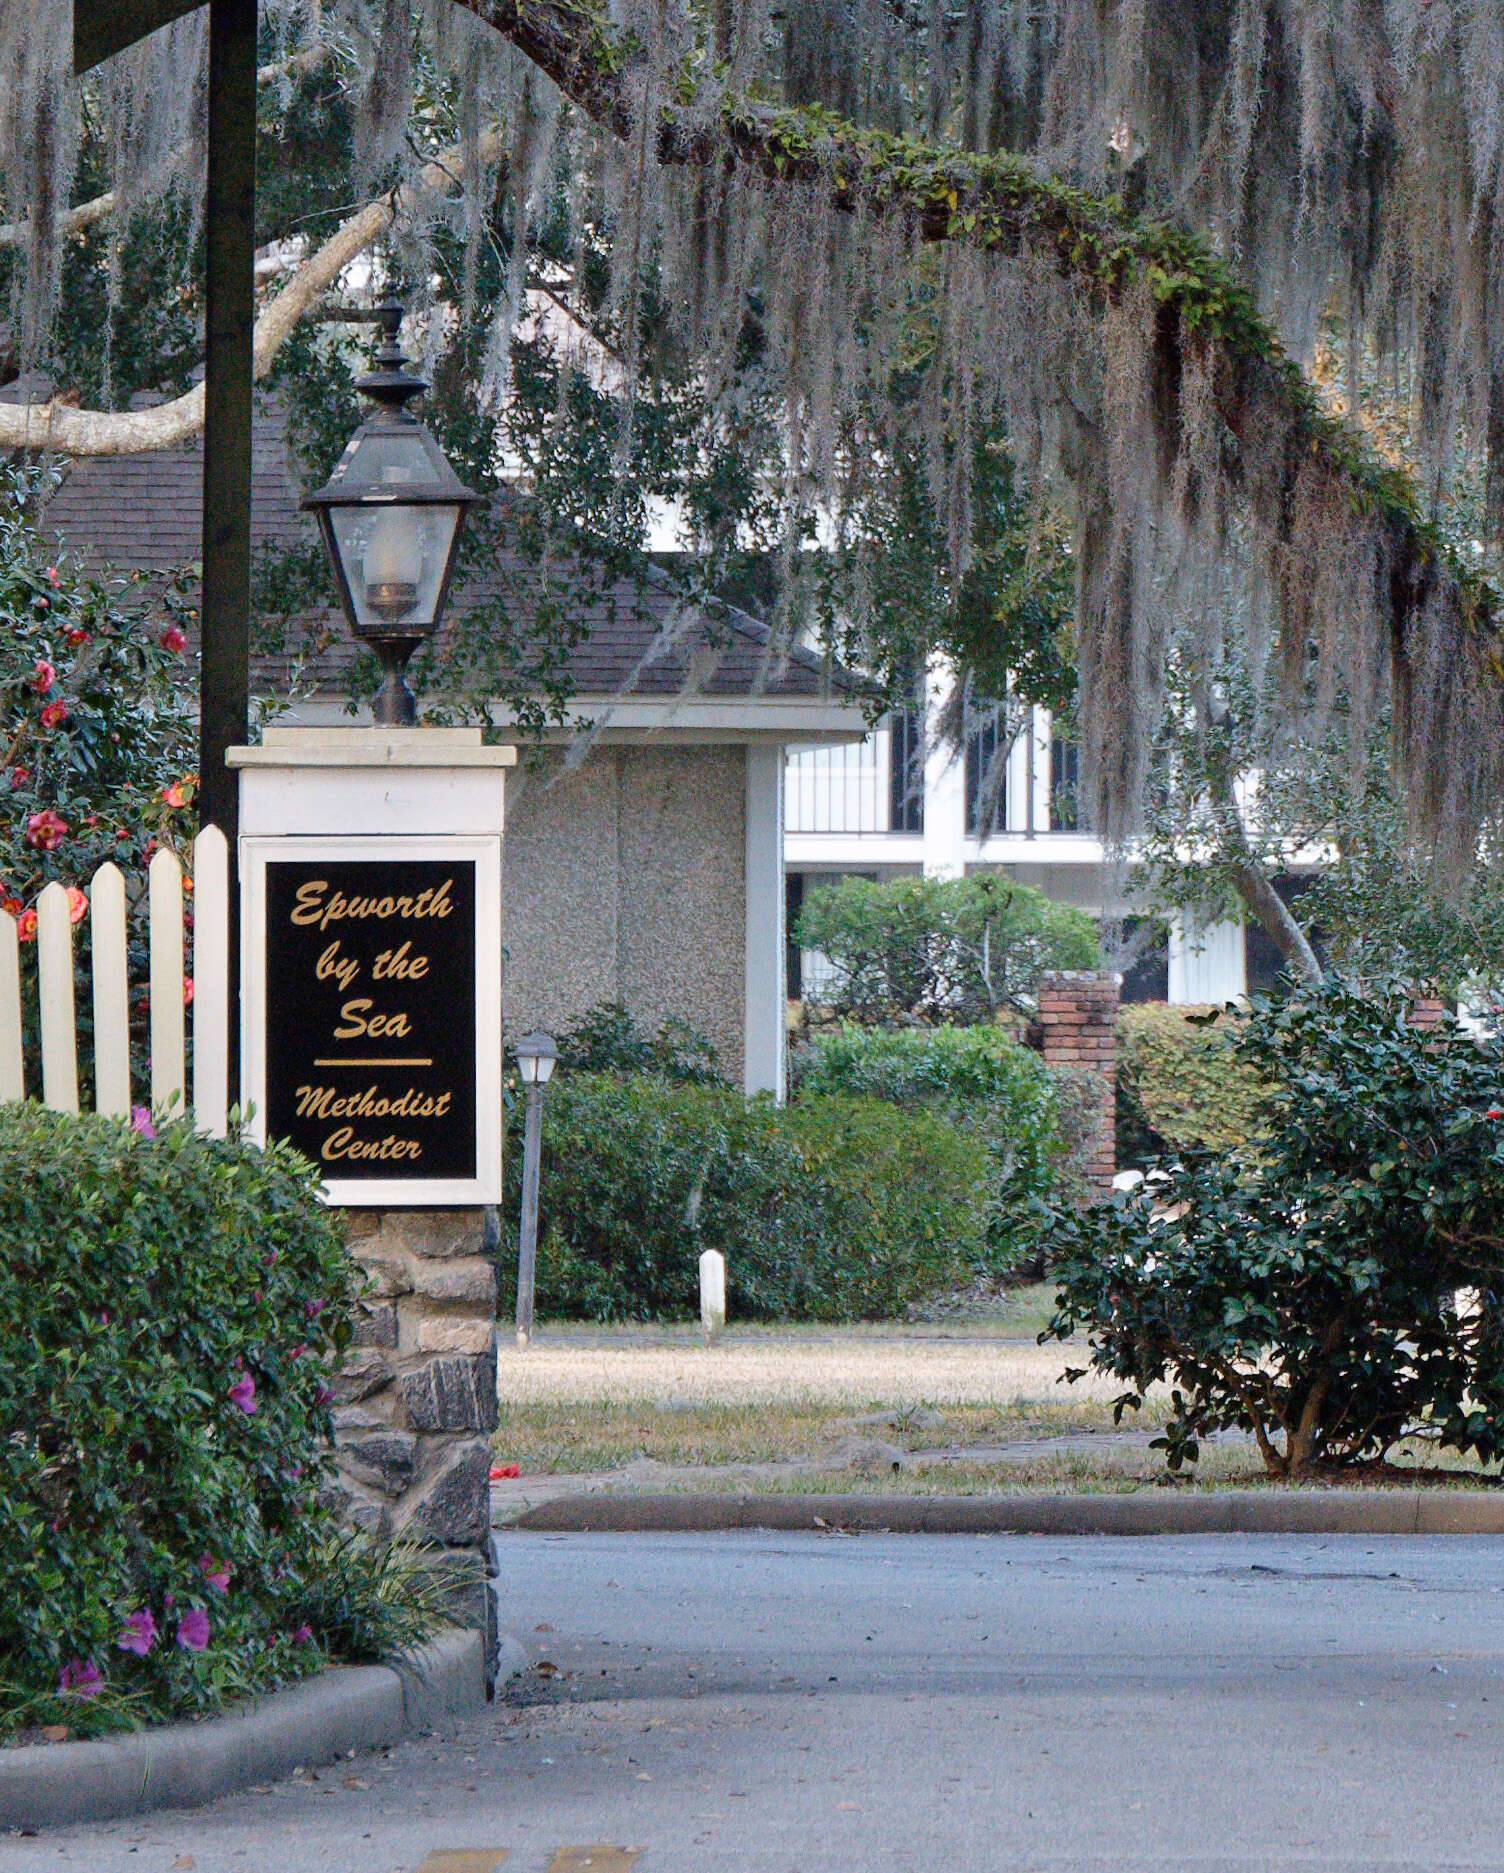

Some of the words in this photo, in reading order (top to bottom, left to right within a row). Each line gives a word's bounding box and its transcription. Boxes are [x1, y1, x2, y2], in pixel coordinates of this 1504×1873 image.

[290, 880, 453, 931] Epworth
[316, 940, 361, 992] by
[372, 942, 430, 980] the
[334, 999, 411, 1039] Sea
[295, 1085, 450, 1119] Methodist
[321, 1126, 422, 1161] Center
